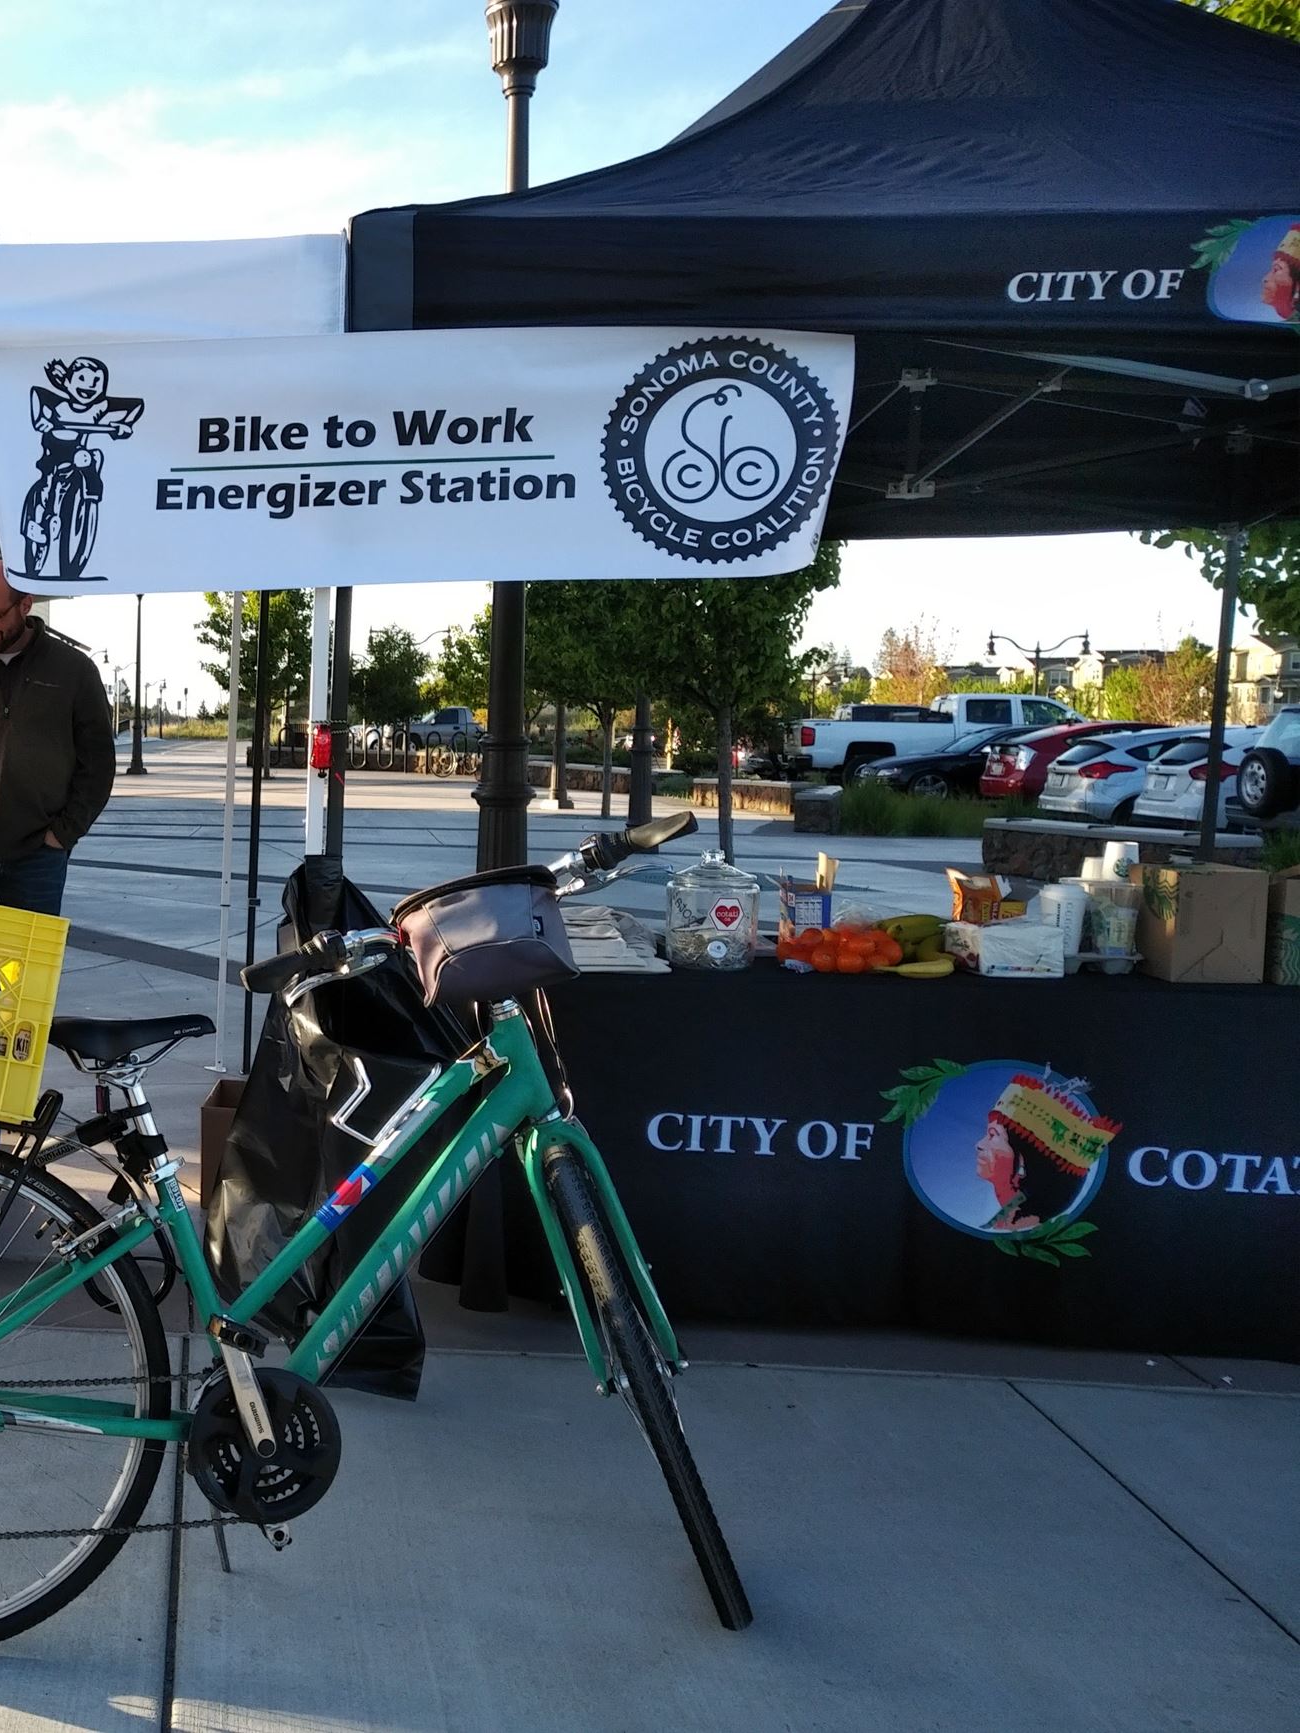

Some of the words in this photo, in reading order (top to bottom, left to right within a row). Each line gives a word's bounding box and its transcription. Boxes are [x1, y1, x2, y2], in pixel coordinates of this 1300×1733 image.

[1007, 270, 1117, 302] CITY
[1122, 269, 1185, 300] OF
[620, 350, 720, 434] SONOMA
[728, 350, 825, 425] COUNTY
[198, 412, 308, 454] Bike
[323, 415, 376, 449] to
[393, 407, 534, 447] Work
[156, 473, 386, 520] Energizer
[401, 465, 576, 505] Station
[616, 456, 703, 548] BICYCLE
[710, 446, 827, 549] COALITION
[647, 1112, 788, 1157] CITY
[797, 1120, 875, 1161] OF
[1128, 1146, 1300, 1195] COTA
[249, 1401, 265, 1434] SHIMANO
